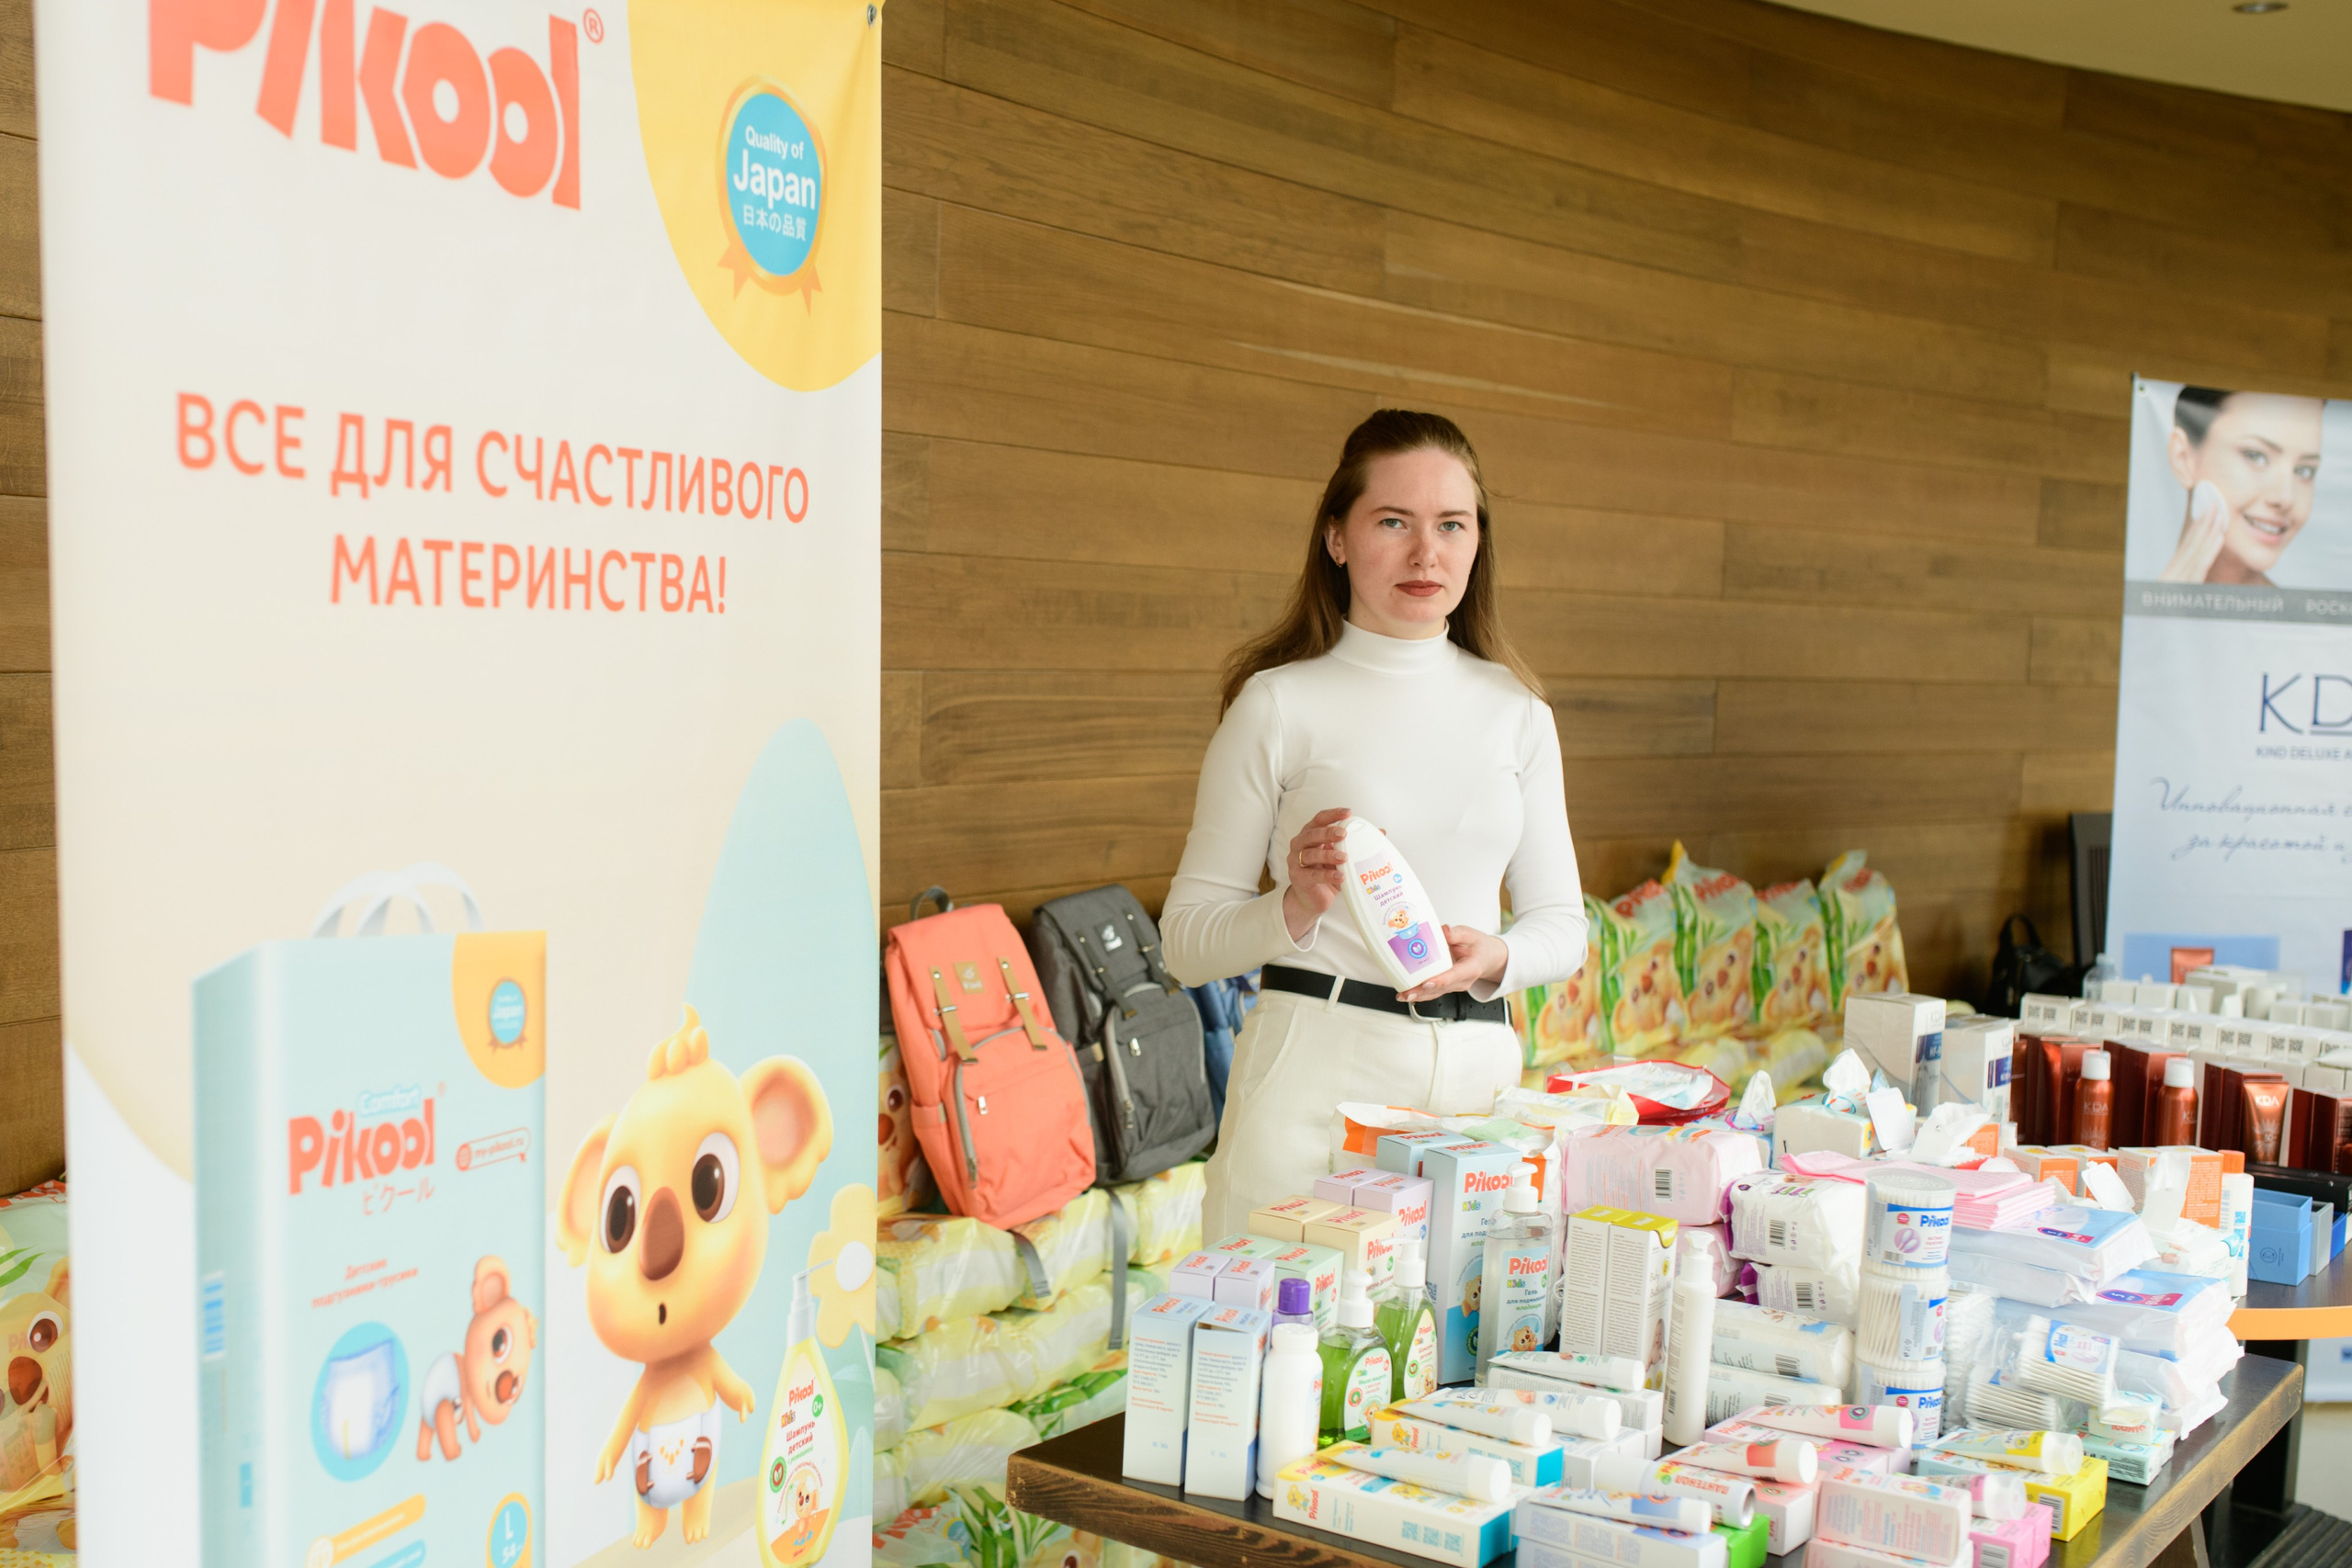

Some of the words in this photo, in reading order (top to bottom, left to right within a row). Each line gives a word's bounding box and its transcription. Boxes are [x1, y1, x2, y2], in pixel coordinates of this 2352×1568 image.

[745, 125, 788, 160] Quality
[791, 141, 804, 160] of
[733, 149, 816, 209] Japan
[743, 204, 806, 242] 日本の品質
[176, 391, 306, 479] ВСЕ
[330, 412, 452, 499] ДЛЯ
[476, 430, 810, 524] СЧАСТЛИВОГО
[330, 534, 727, 615] МАТЕРИНСТВА!
[2142, 591, 2284, 614] ВНИМАТЕЛЬНЫЙ
[1360, 862, 1394, 886] Pikool
[1374, 885, 1403, 901] Шампунь
[1380, 891, 1404, 908] детский
[2084, 1102, 2109, 1113] KDA
[2256, 1095, 2279, 1106] KDA
[1463, 1200, 1481, 1212] Kids
[1509, 1254, 1548, 1275] Pikool
[789, 1379, 814, 1406] Pikool
[786, 1421, 815, 1442] Шампунь
[788, 1432, 813, 1456] детский
